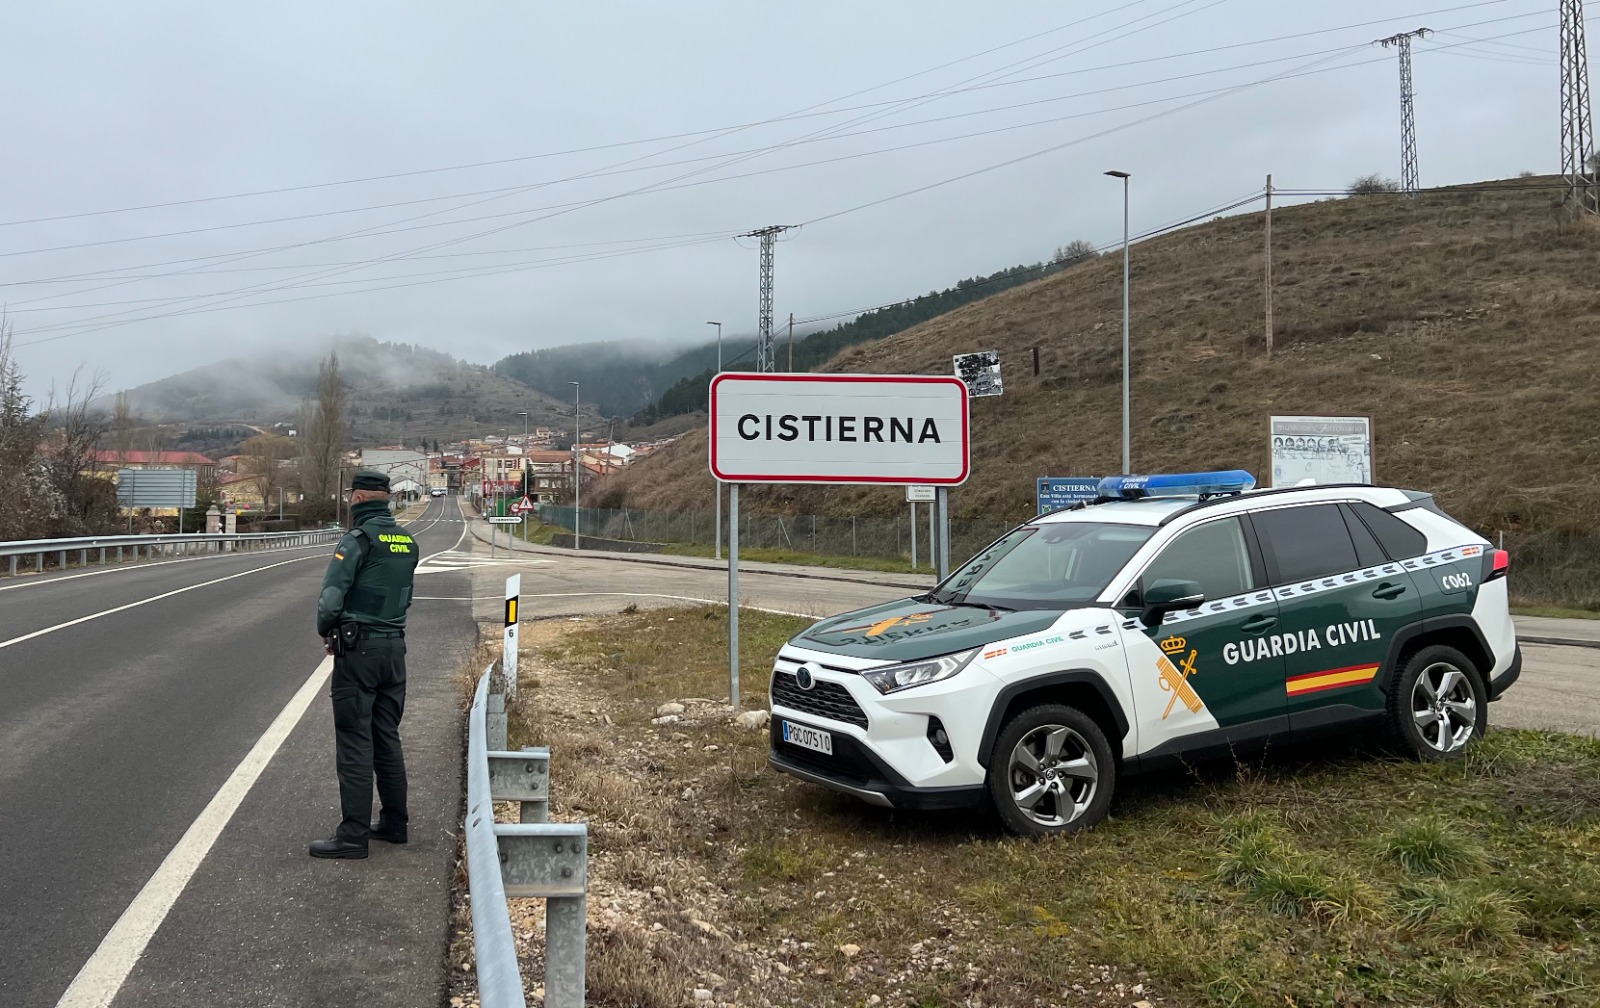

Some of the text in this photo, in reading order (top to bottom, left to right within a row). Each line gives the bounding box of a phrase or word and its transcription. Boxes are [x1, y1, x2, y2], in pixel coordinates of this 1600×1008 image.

[737, 414, 941, 444] CISTIERNA
[1053, 484, 1097, 492] CISTIERNA
[378, 534, 413, 543] GUARDIA
[390, 544, 410, 553] CIVIL
[508, 628, 515, 638] 6
[1011, 635, 1065, 652] GUARDIA CIVIL
[1223, 619, 1381, 665] GUARDIA CIVIL
